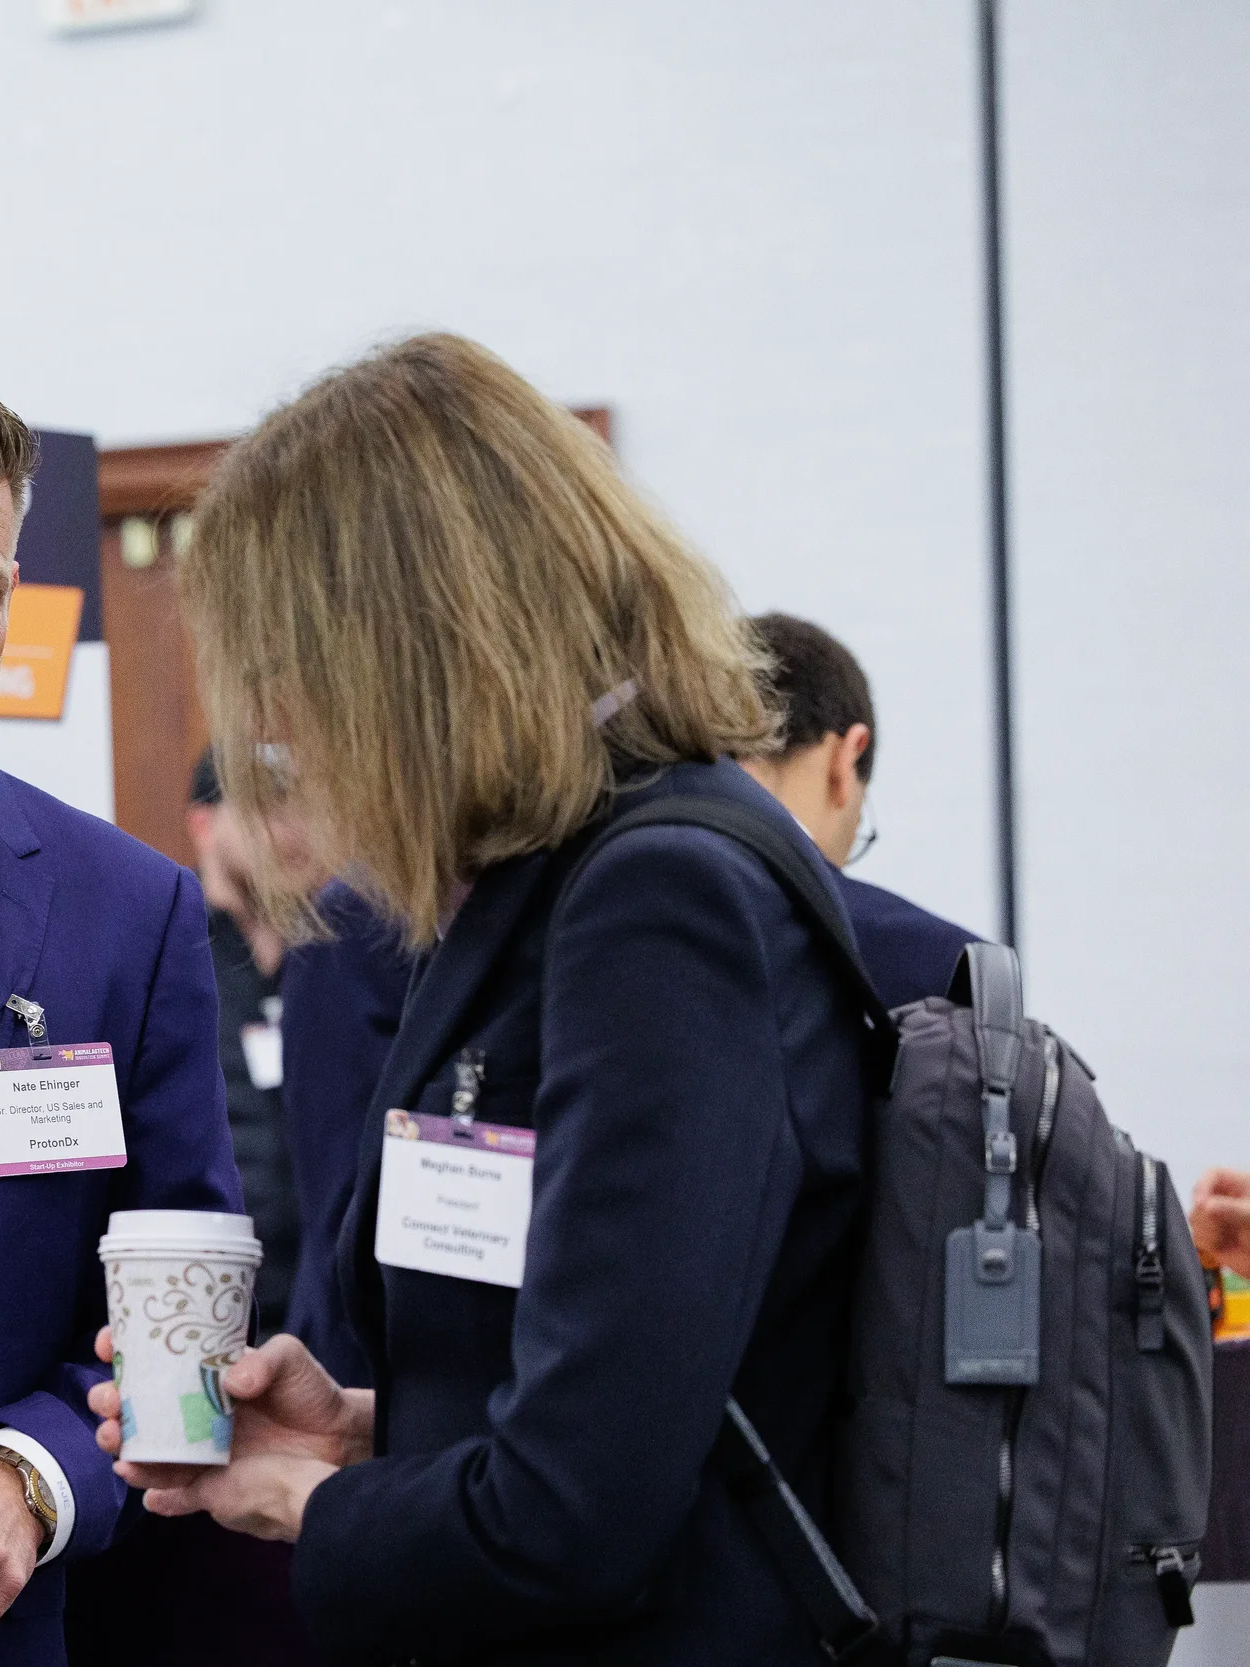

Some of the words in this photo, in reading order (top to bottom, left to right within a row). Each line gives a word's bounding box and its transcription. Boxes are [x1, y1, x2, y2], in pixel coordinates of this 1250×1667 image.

[13, 1081, 37, 1092] Nate
[40, 1079, 80, 1091] Ehinger
[10, 1104, 45, 1115] Director,
[47, 1103, 60, 1112] US
[62, 1101, 86, 1111] Sales
[88, 1100, 103, 1109] and
[31, 1114, 71, 1124] Marketing
[30, 1137, 79, 1149] ProtonDx
[30, 1162, 55, 1171] Start-Up
[56, 1161, 85, 1169] Exhibitor
